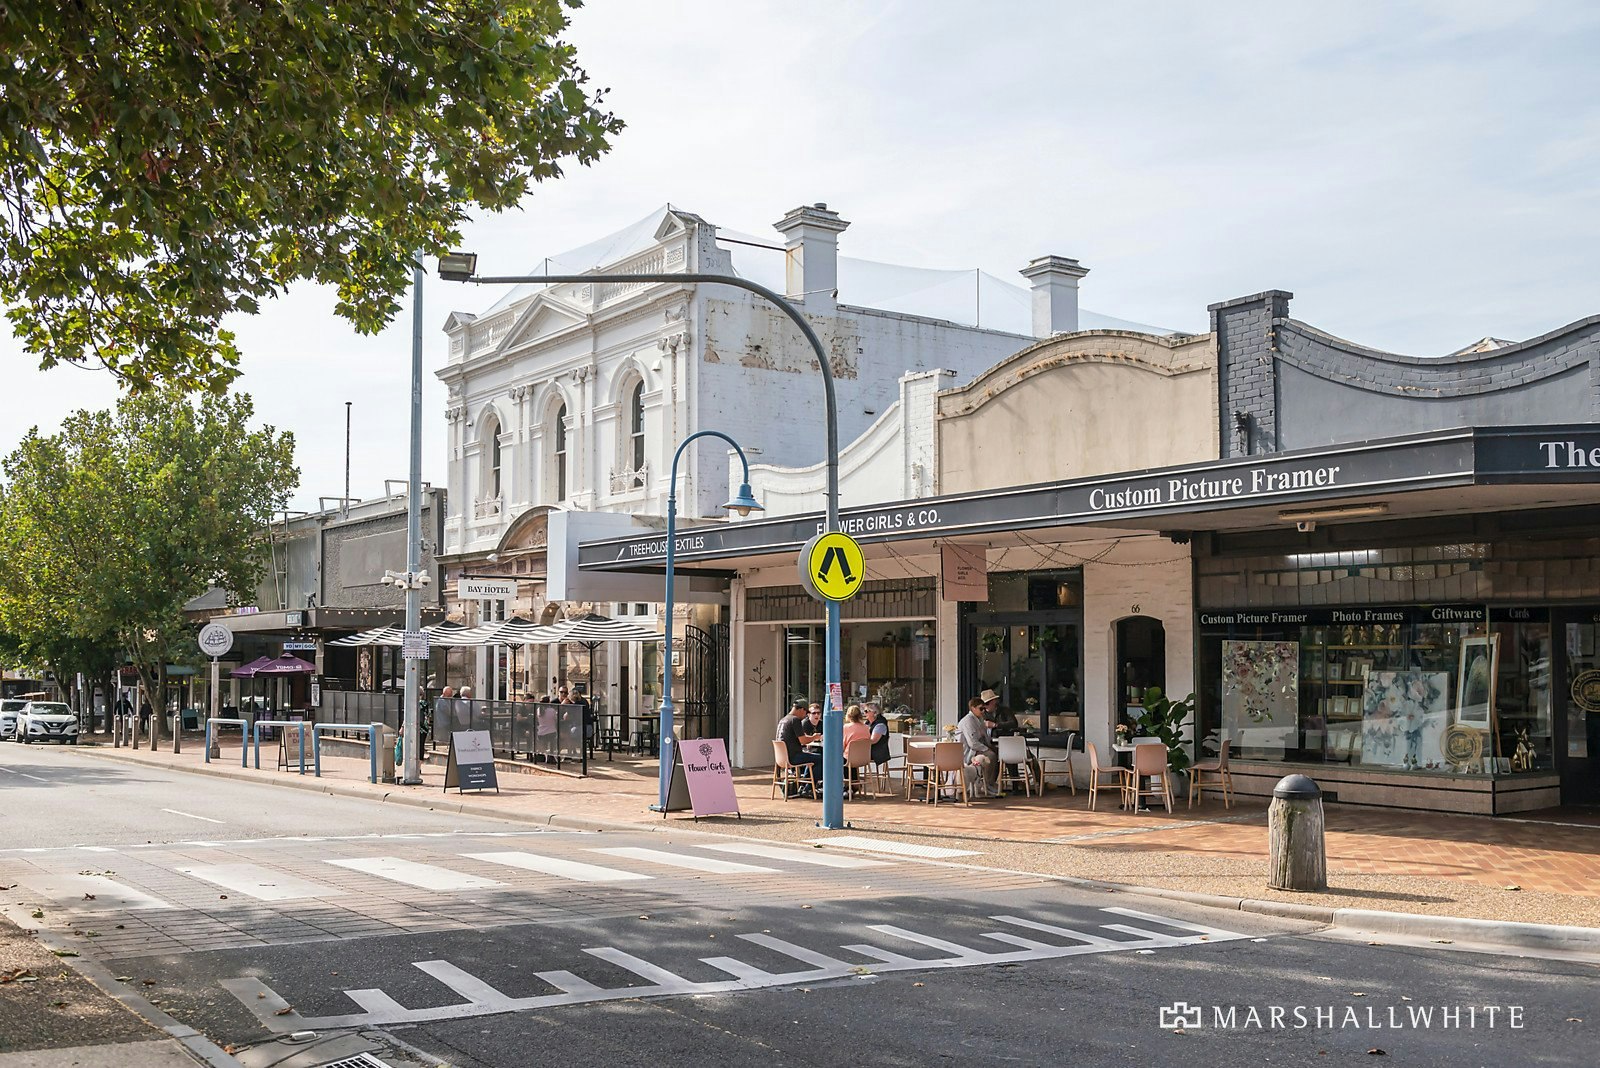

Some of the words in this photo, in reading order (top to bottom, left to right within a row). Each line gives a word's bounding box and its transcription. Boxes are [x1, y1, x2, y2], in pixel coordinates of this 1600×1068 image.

[1539, 441, 1600, 468] The
[1089, 486, 1162, 510] Custom
[1168, 477, 1244, 502] Picture
[1250, 466, 1340, 493] Framer
[866, 513, 903, 531] GIRLS
[906, 512, 916, 527] &
[918, 509, 942, 525] CO.
[674, 536, 704, 551] EXTILES
[467, 585, 483, 593] BAY
[484, 586, 511, 594] HOTEL
[1131, 604, 1141, 614] 66
[1332, 611, 1362, 622] Photo
[1364, 609, 1404, 621] Frames
[1431, 607, 1482, 620] Giftware
[1509, 607, 1530, 619] Cards
[1201, 614, 1234, 625] Custom
[1237, 612, 1269, 623] Picture
[1271, 611, 1308, 623] Framer
[687, 763, 707, 772] Flower
[709, 761, 725, 771] Girls
